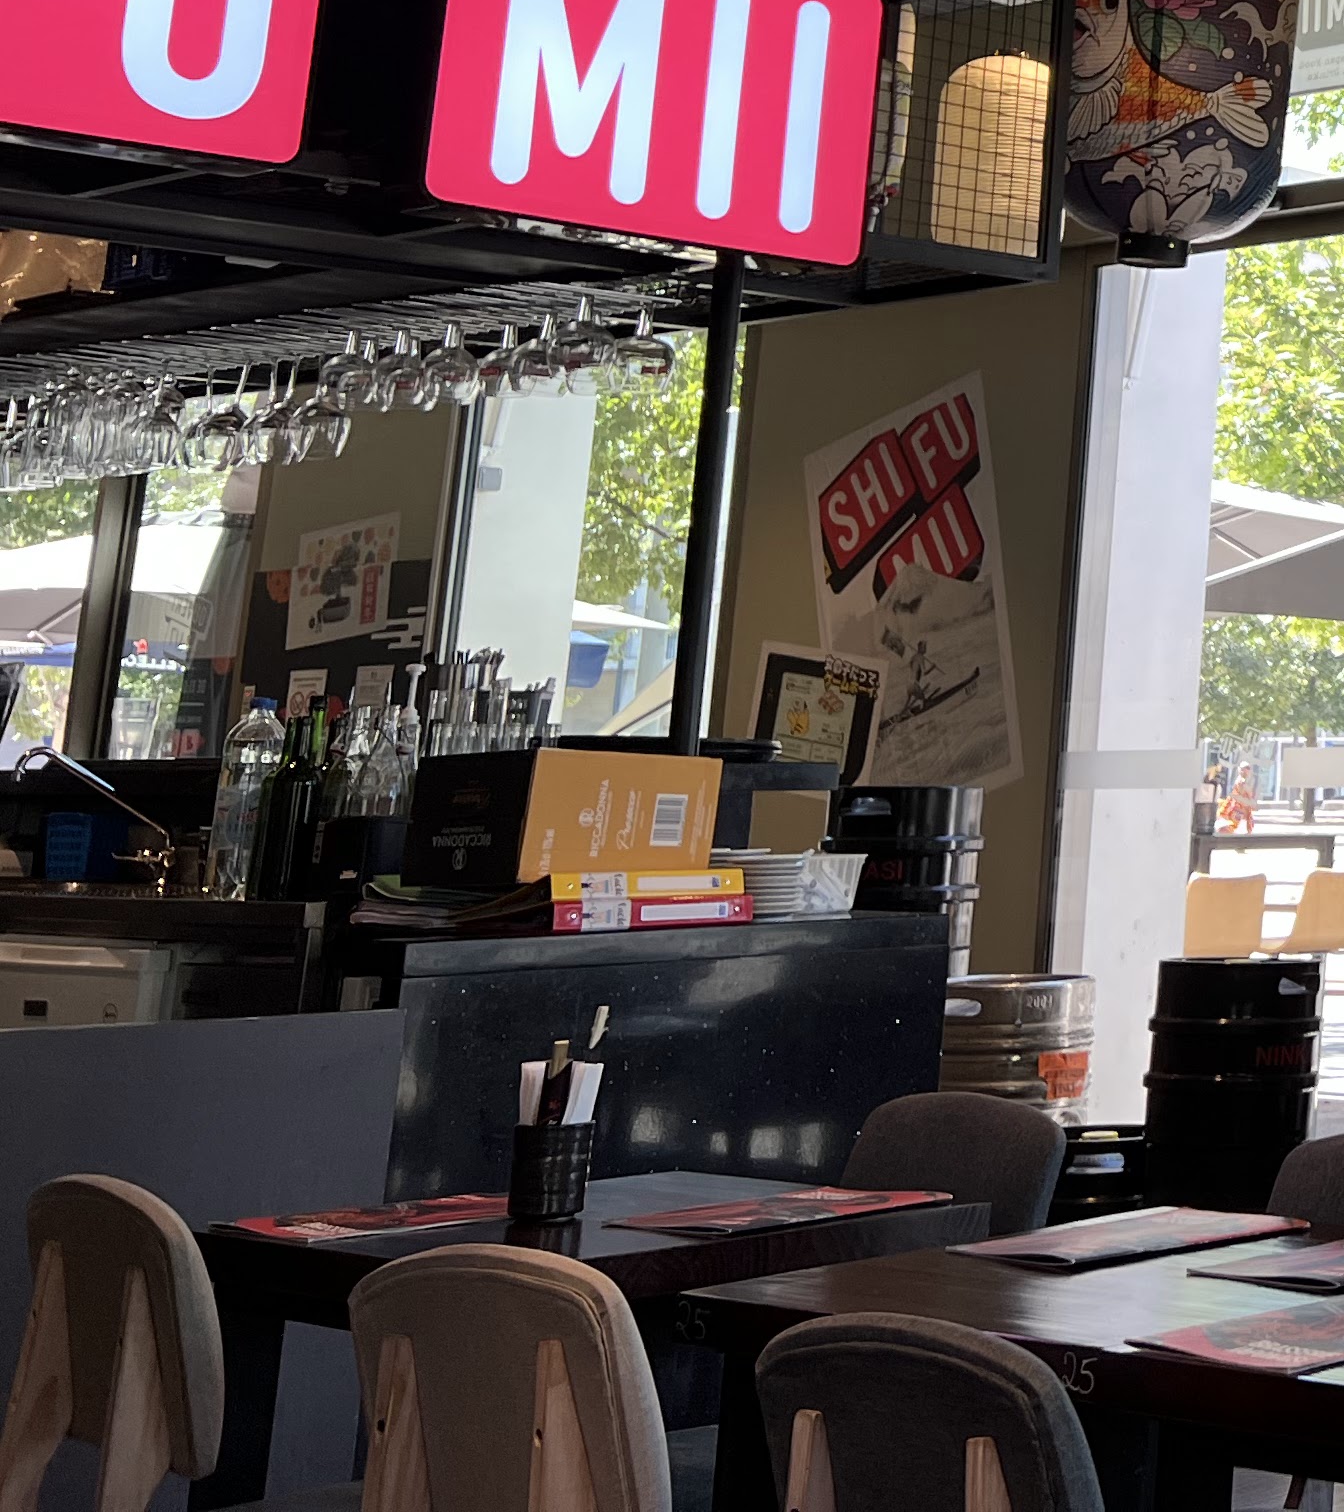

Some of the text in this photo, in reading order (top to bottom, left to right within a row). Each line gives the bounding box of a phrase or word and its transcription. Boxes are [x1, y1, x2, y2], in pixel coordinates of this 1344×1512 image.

[910, 398, 971, 489] FU
[827, 442, 905, 551] SHI
[589, 778, 610, 858] RICCADONNA
[675, 1299, 711, 1341] 25
[1061, 1351, 1099, 1395] 25
